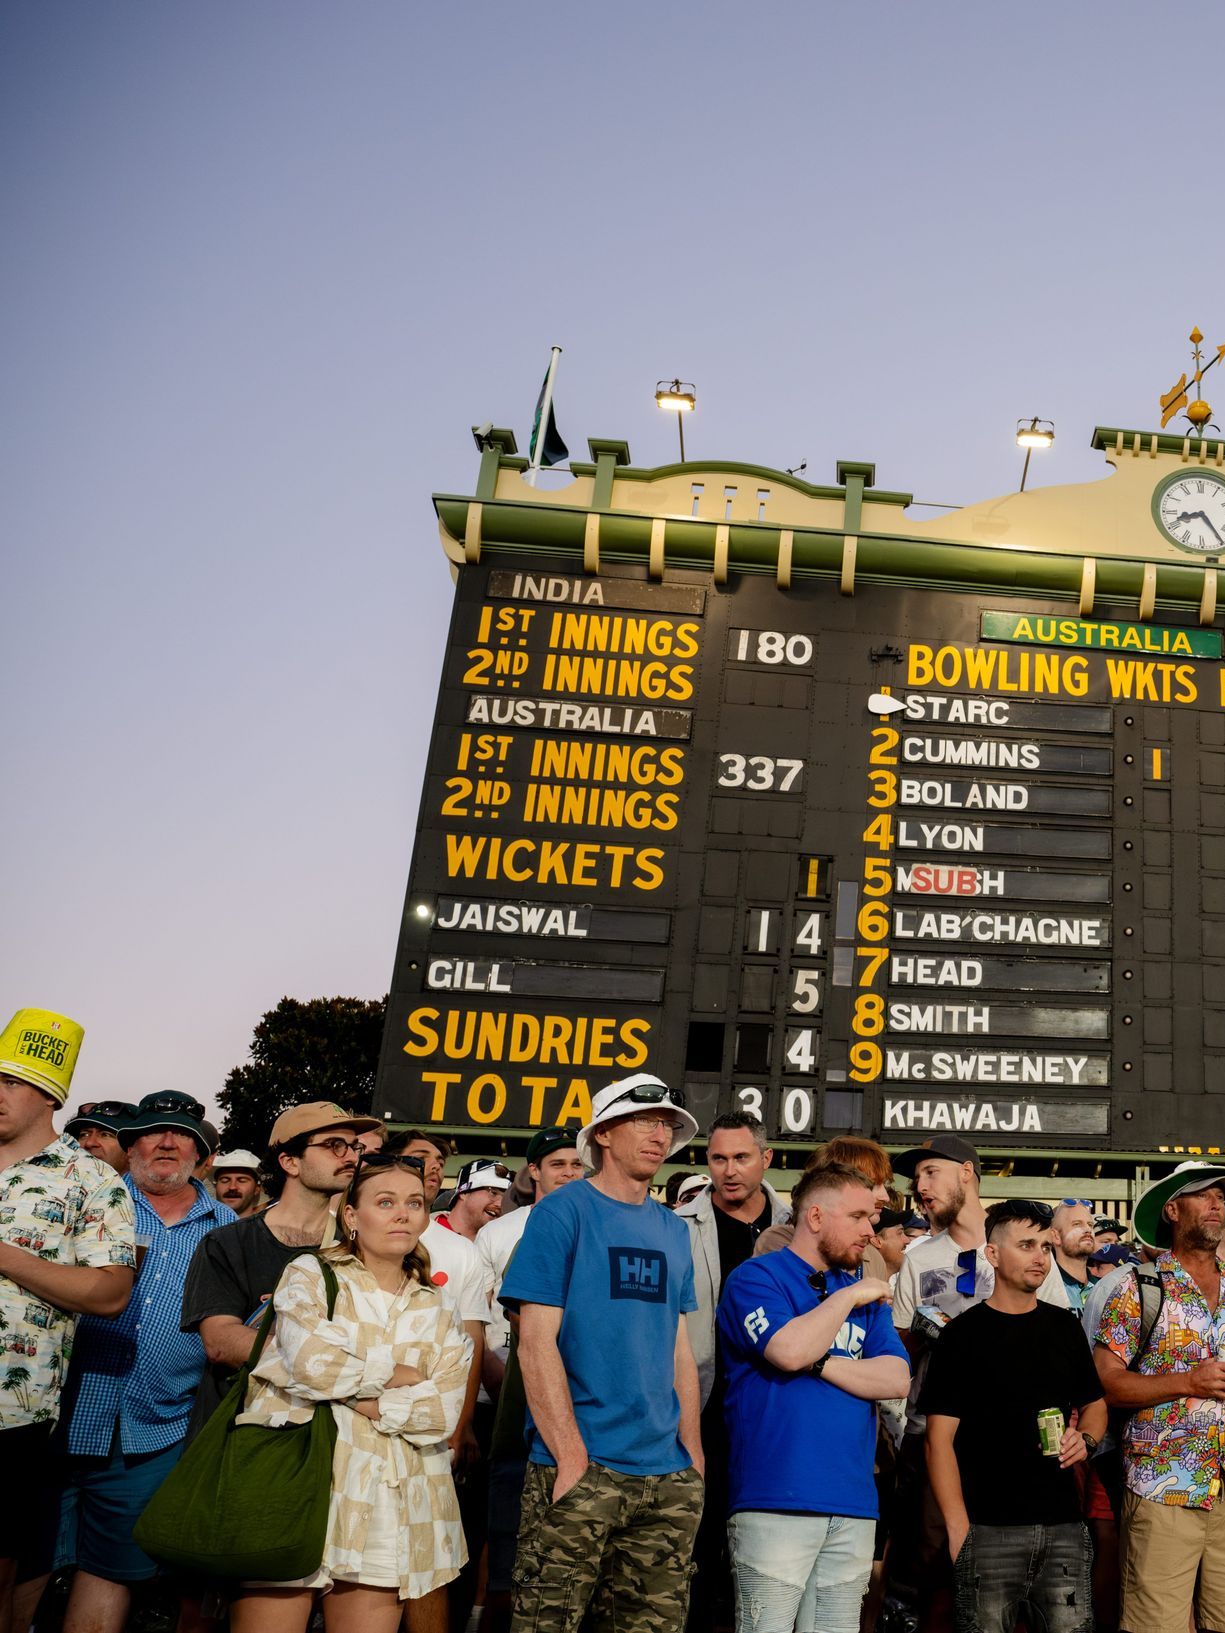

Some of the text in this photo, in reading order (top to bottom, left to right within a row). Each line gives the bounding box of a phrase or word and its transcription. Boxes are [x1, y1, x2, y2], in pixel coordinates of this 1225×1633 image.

[512, 575, 602, 603] INDIA
[549, 612, 700, 658] INNINGS
[737, 630, 812, 665] 180
[1012, 619, 1192, 653] AUSTRALIA
[463, 649, 694, 700] 2ND INNINGS
[907, 643, 1089, 696] BOWLING
[1106, 658, 1197, 703] WKTS
[469, 696, 656, 735] AUSTRALIA
[906, 695, 1010, 723] STARC
[531, 740, 684, 785] INNINGS
[869, 727, 899, 765] 2
[904, 737, 1040, 769] CUMMINS
[718, 754, 803, 791] 337
[867, 770, 1028, 809] 3 BOLAND
[441, 777, 679, 830] 2ND INNINGS
[863, 814, 983, 851] 4 LYON
[447, 835, 664, 890] WICKETS
[864, 857, 892, 896] 5
[911, 866, 977, 895] SUB
[438, 903, 587, 936] JAISWAL
[858, 901, 889, 941] 6
[428, 960, 819, 1012] GILL 5
[857, 947, 982, 986] 7 HEAD
[852, 994, 989, 1036] 8 SMITH
[23, 1032, 69, 1053] BUCKET
[26, 1043, 64, 1066] HEAD
[403, 1008, 814, 1071] SUNDRIES 4
[849, 1042, 882, 1082] 9
[421, 1071, 594, 1127] TOTA
[885, 1100, 1043, 1132] KHAWAJA
[619, 1256, 660, 1286] HH
